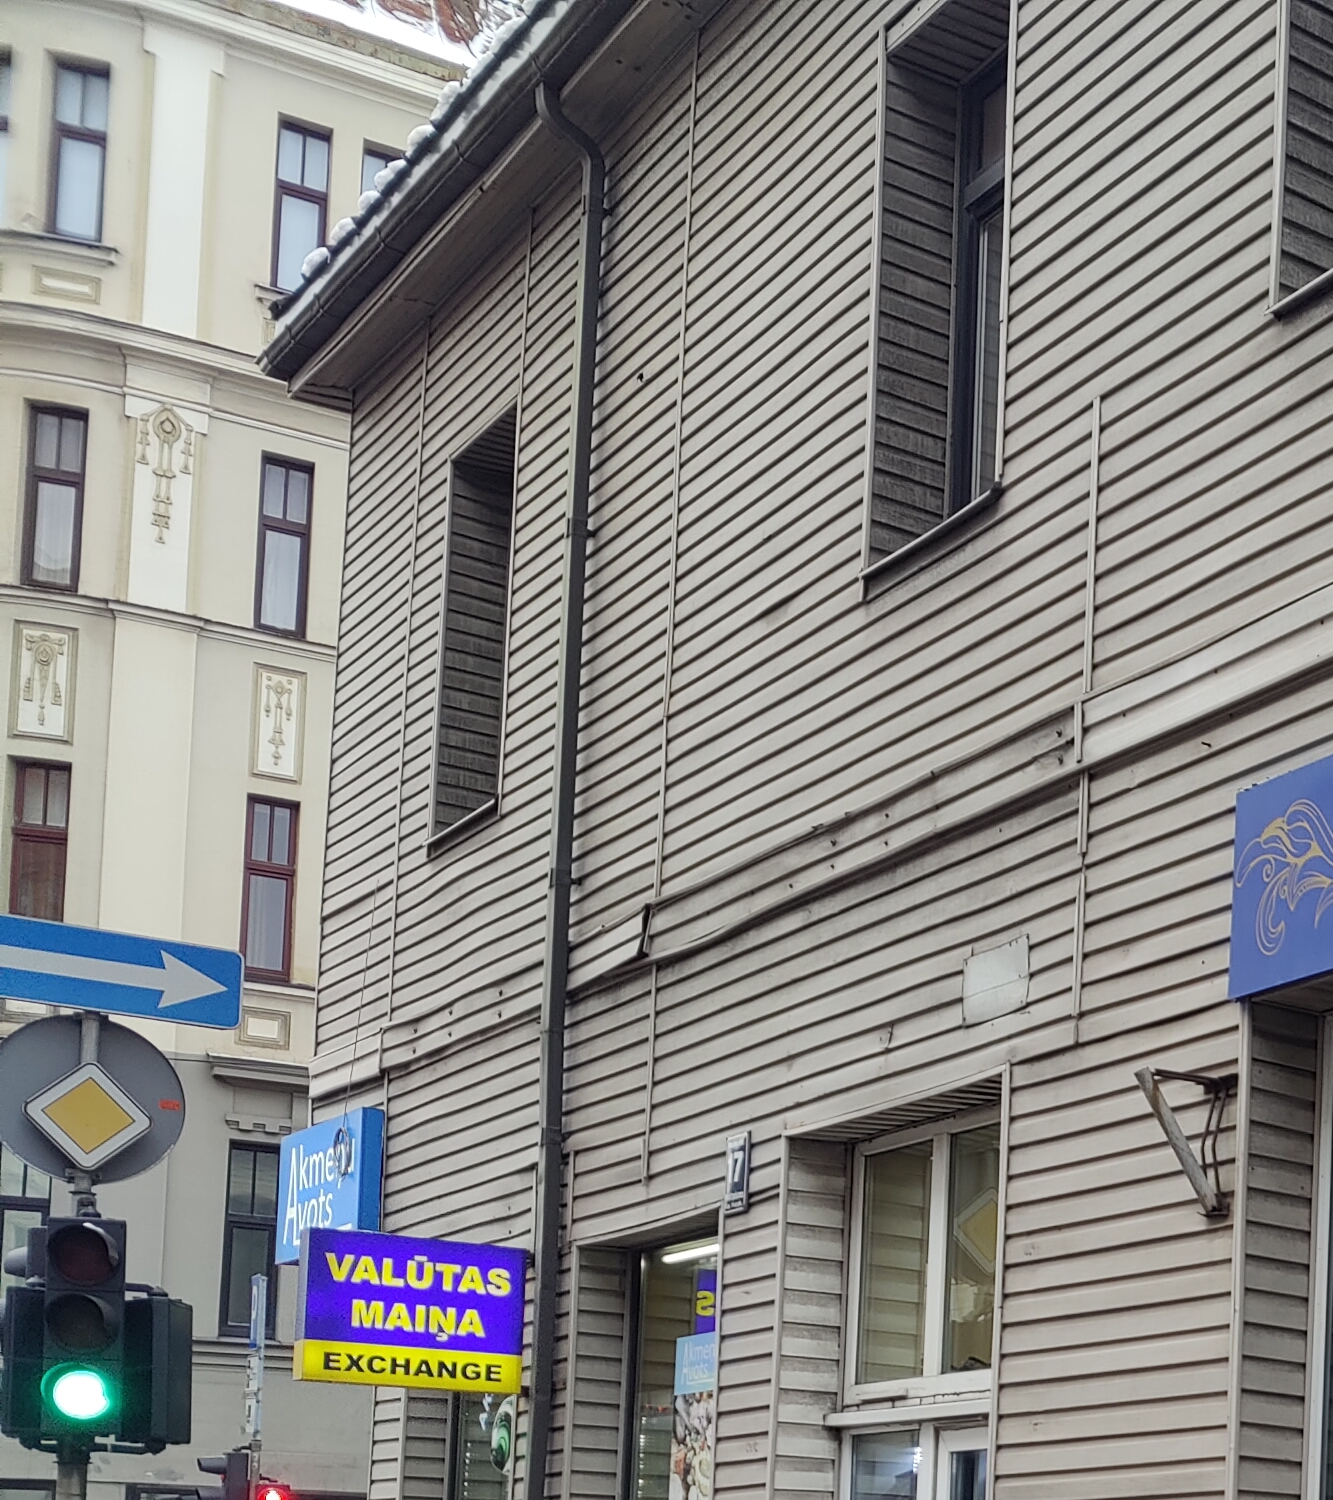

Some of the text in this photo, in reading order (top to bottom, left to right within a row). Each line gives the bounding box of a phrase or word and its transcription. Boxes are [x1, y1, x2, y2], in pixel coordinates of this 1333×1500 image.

[325, 1252, 511, 1297] VALŪTAS
[351, 1299, 486, 1342] MAIŅA
[323, 1352, 502, 1382] EXCHANGE
